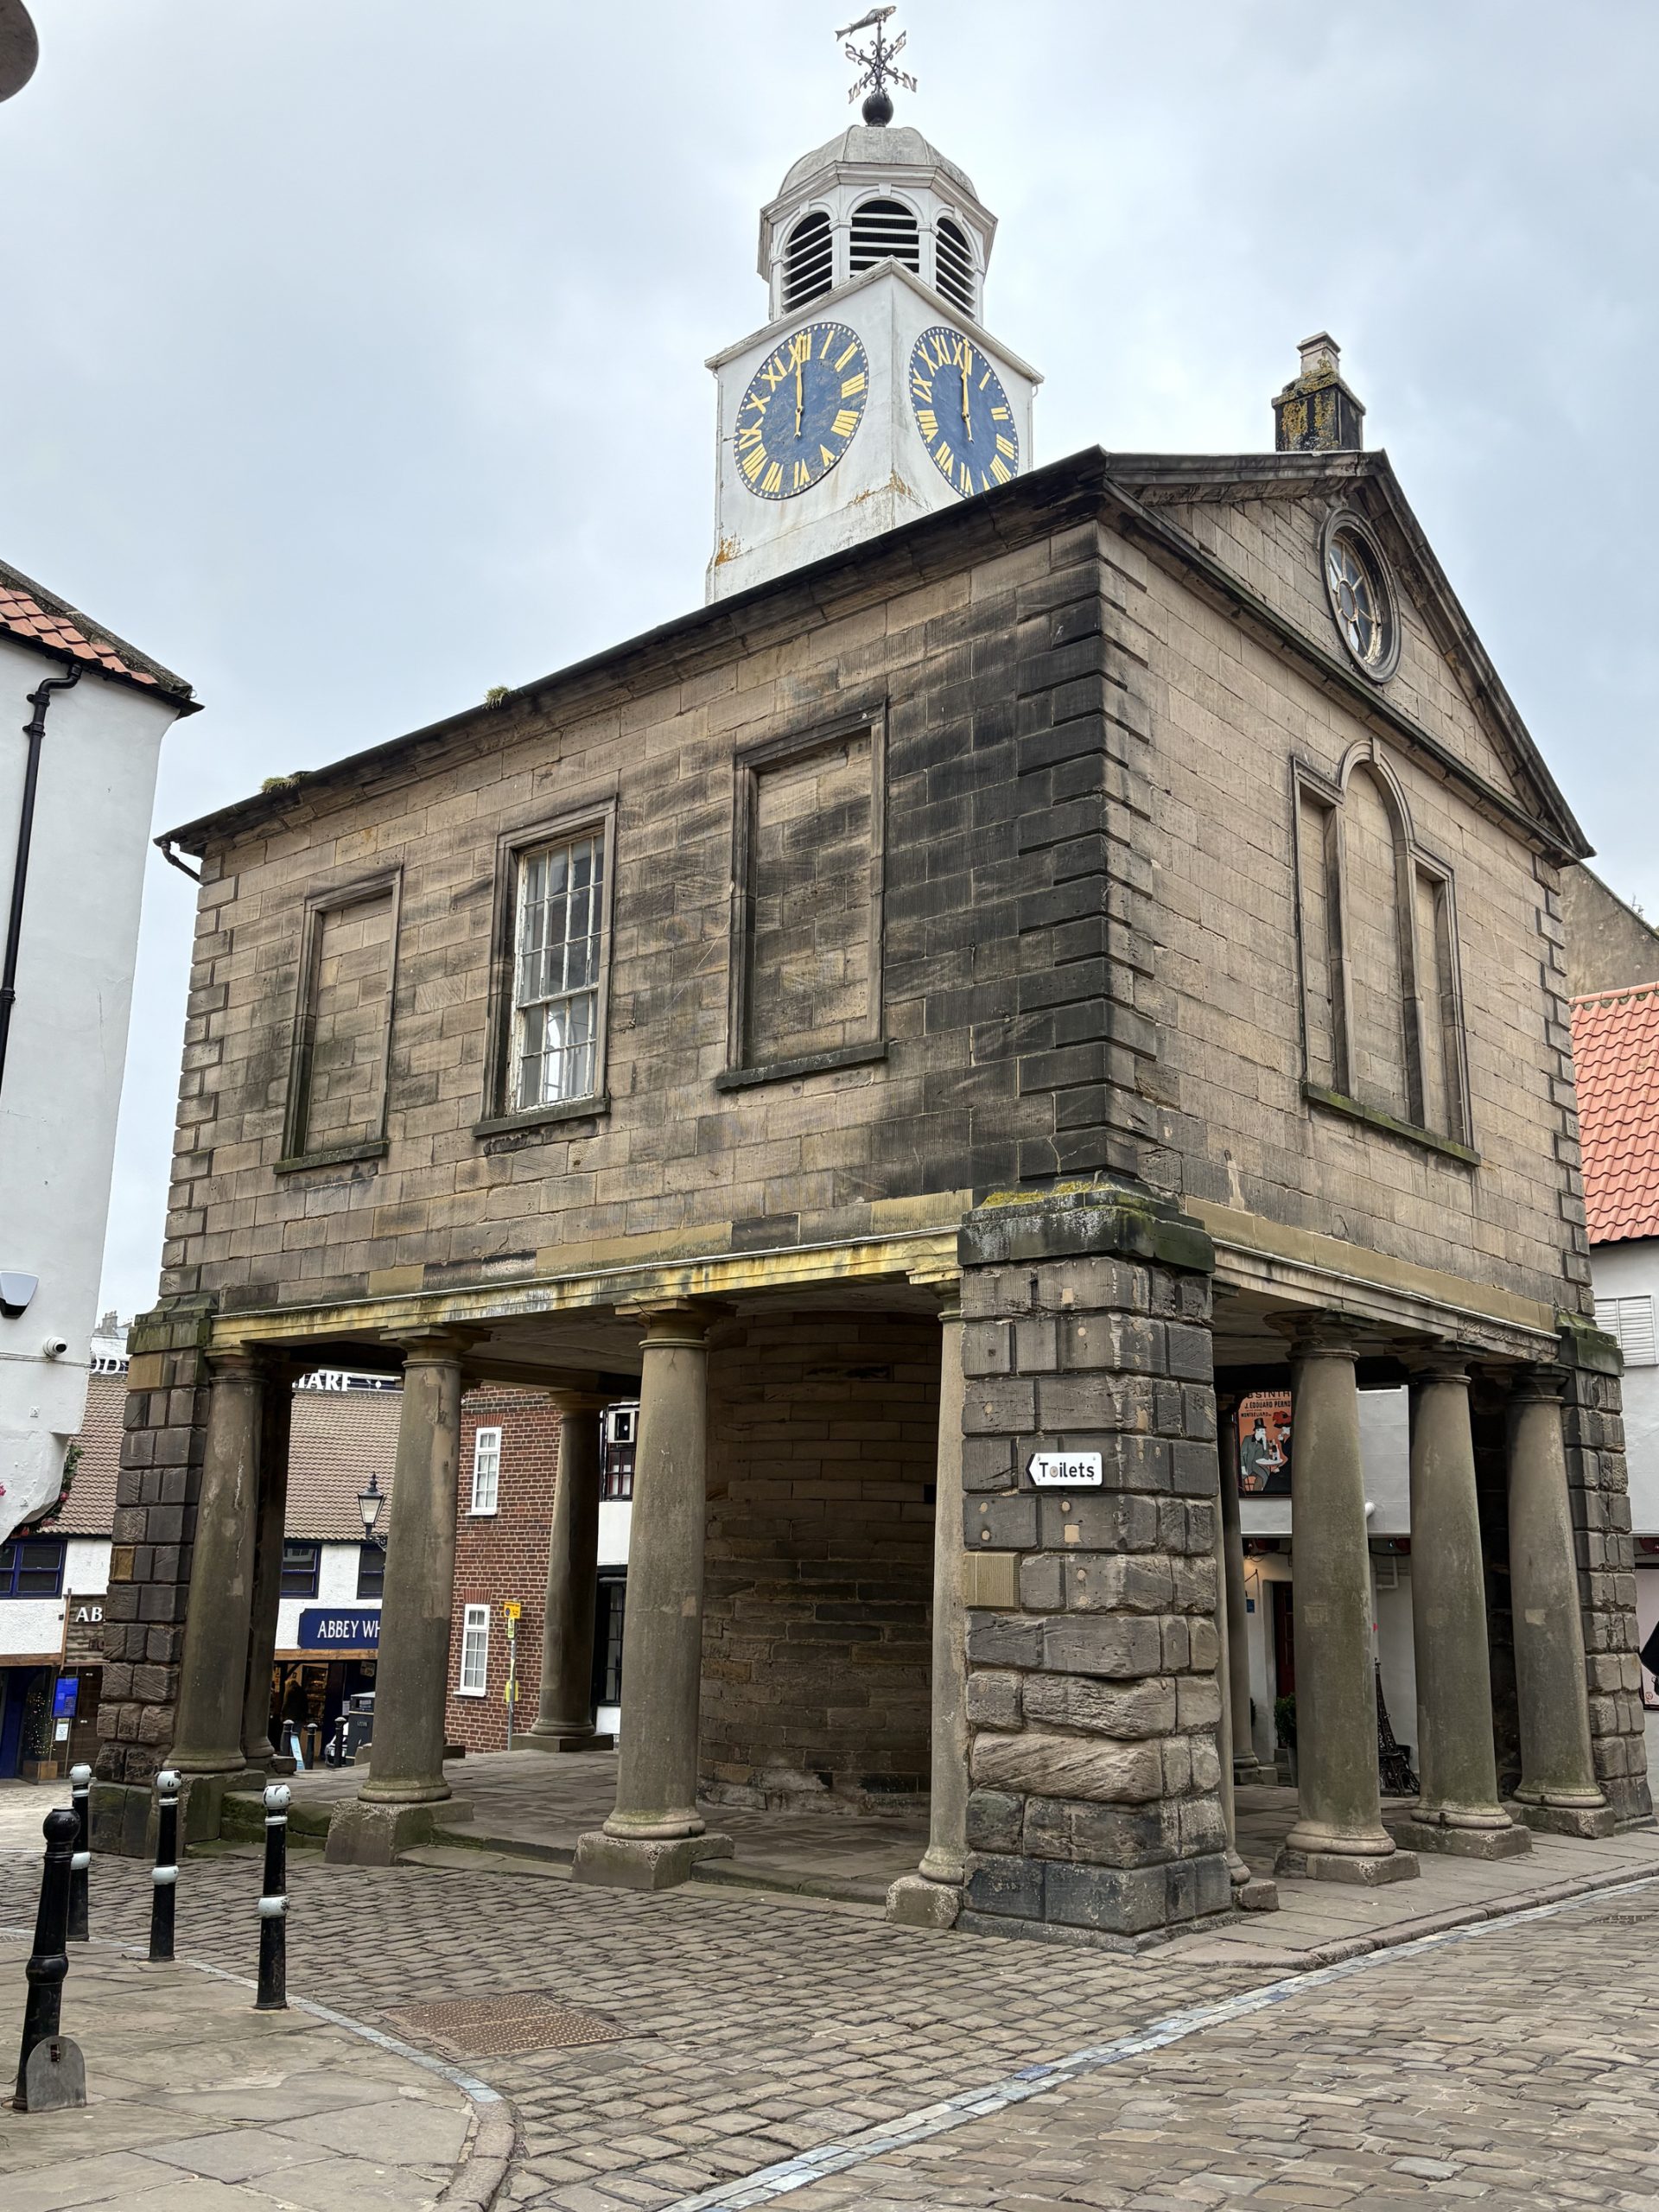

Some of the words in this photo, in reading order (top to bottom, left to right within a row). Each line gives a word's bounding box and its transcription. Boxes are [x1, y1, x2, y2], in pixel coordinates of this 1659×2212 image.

[835, 342, 858, 372] II
[918, 343, 939, 377] X
[761, 357, 788, 392] XI
[842, 372, 866, 399] III
[746, 393, 771, 414] X
[991, 407, 1009, 421] II
[820, 443, 836, 467] V
[996, 433, 1014, 461] III
[317, 1619, 359, 1639] ABBEY
